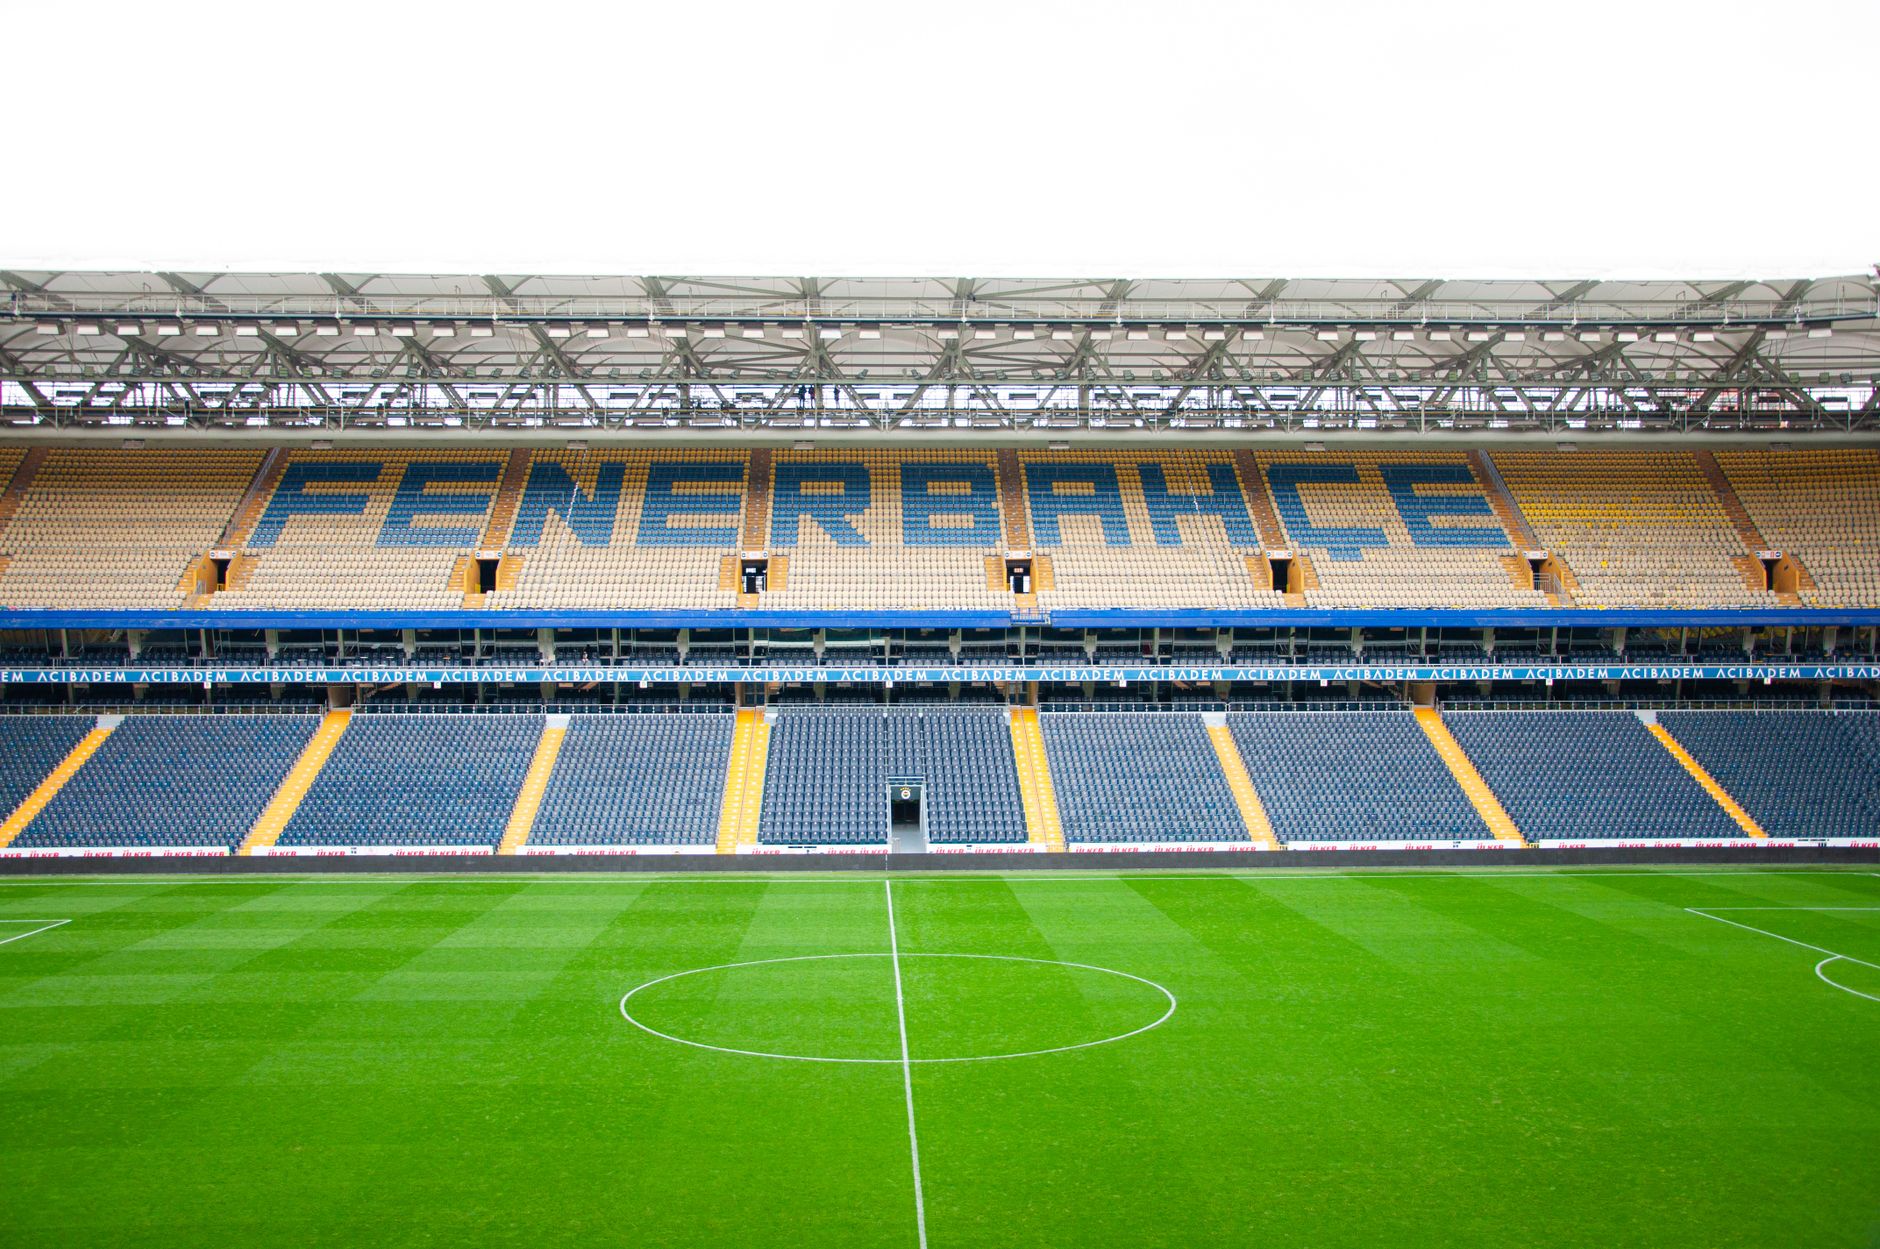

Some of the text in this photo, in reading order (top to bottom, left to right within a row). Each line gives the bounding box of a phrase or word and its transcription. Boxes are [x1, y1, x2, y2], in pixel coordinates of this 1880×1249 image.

[37, 671, 127, 682] ACIBADEM
[139, 671, 227, 682] ACIBADEM
[241, 671, 328, 682] ACIBADEM
[340, 671, 428, 682] ACIBADEM
[441, 671, 527, 682] ACIBADEM
[542, 671, 629, 682] ACIBADEM
[642, 671, 728, 681] ACIBADEM
[741, 671, 828, 681] ACIBADEM
[841, 671, 928, 681] ACIBADEM
[941, 670, 1026, 681] ACIBADEM
[1040, 670, 1126, 681] ACIBADEM
[1138, 670, 1222, 681] ACIBADEM
[1237, 670, 1322, 680] ACIBADEM
[1334, 670, 1418, 680] ACIBADEM
[1430, 669, 1513, 680] ACIBADEM
[1526, 669, 1608, 679] ACIBADEM
[1622, 668, 1704, 679] ACIBADEM
[1717, 668, 1801, 678] ACIBADEM
